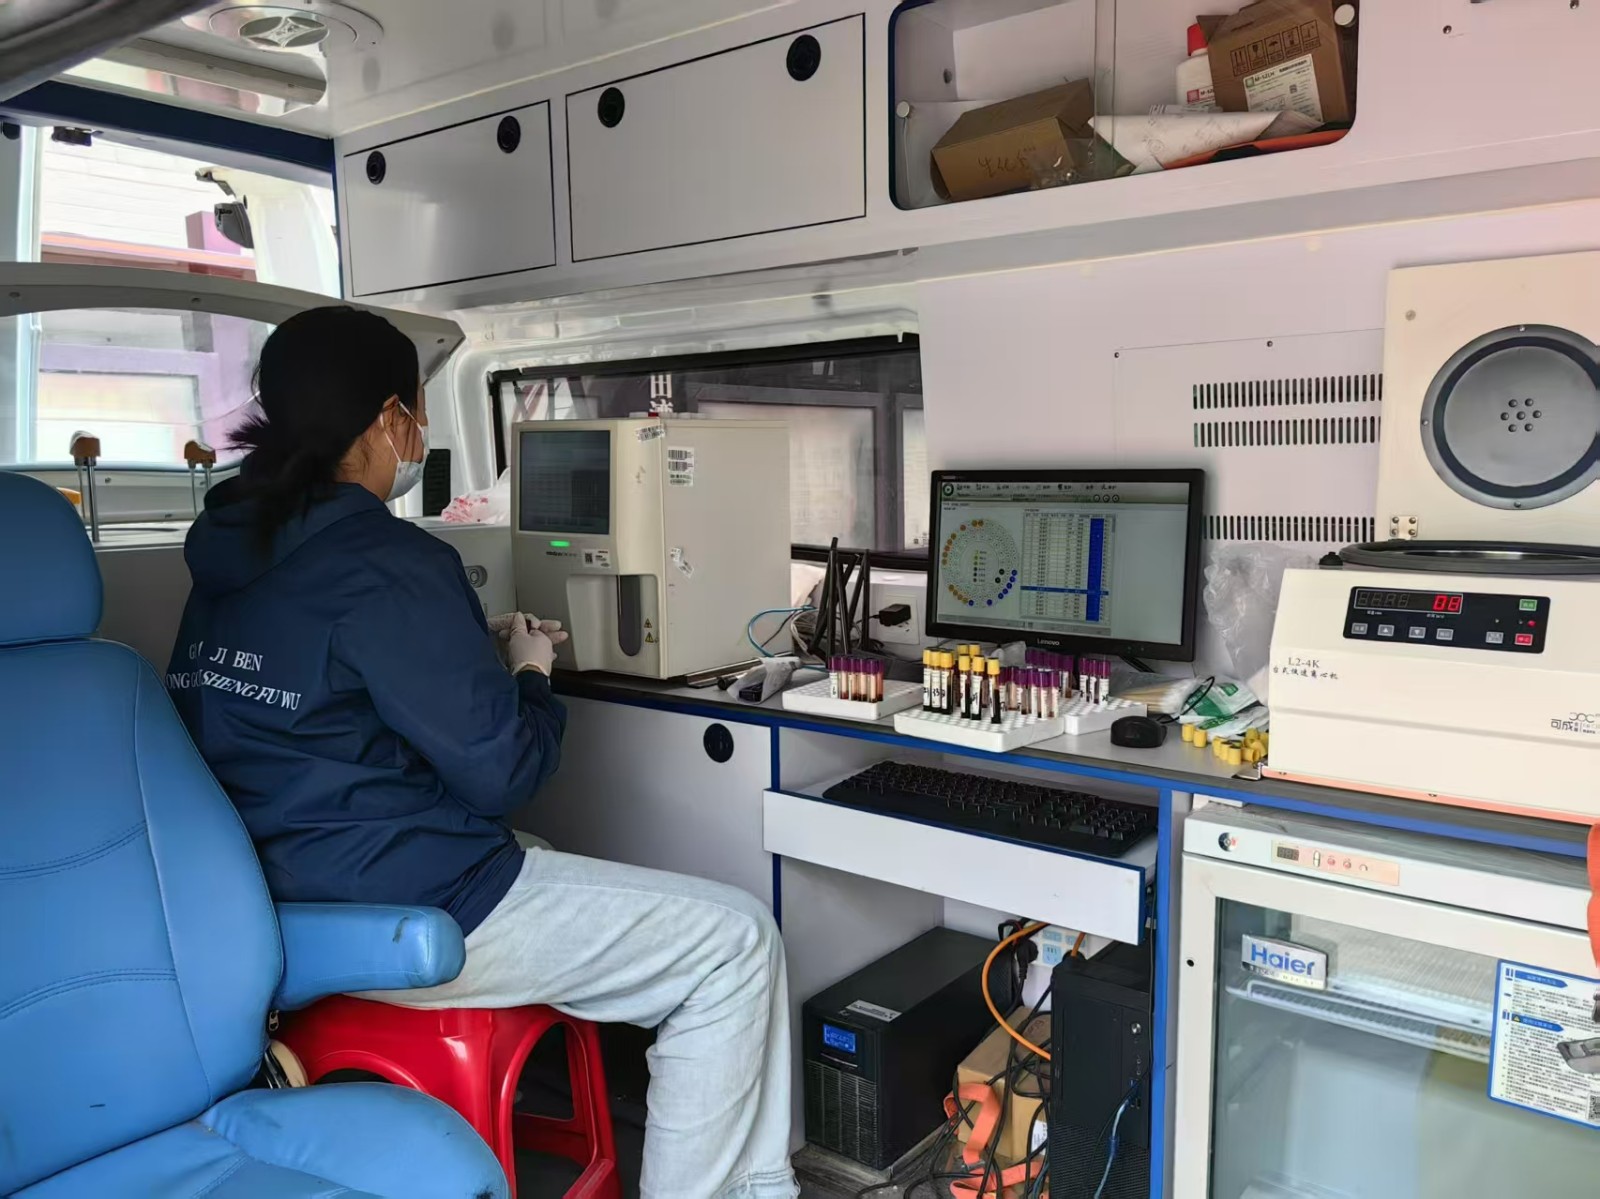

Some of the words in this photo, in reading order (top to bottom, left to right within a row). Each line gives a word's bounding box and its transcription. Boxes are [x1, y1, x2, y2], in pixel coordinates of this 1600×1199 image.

[232, 651, 264, 671] BEN
[1288, 657, 1320, 668] L2-4K
[255, 686, 282, 704] FU
[280, 691, 302, 711] WU
[1251, 943, 1315, 976] Haier
